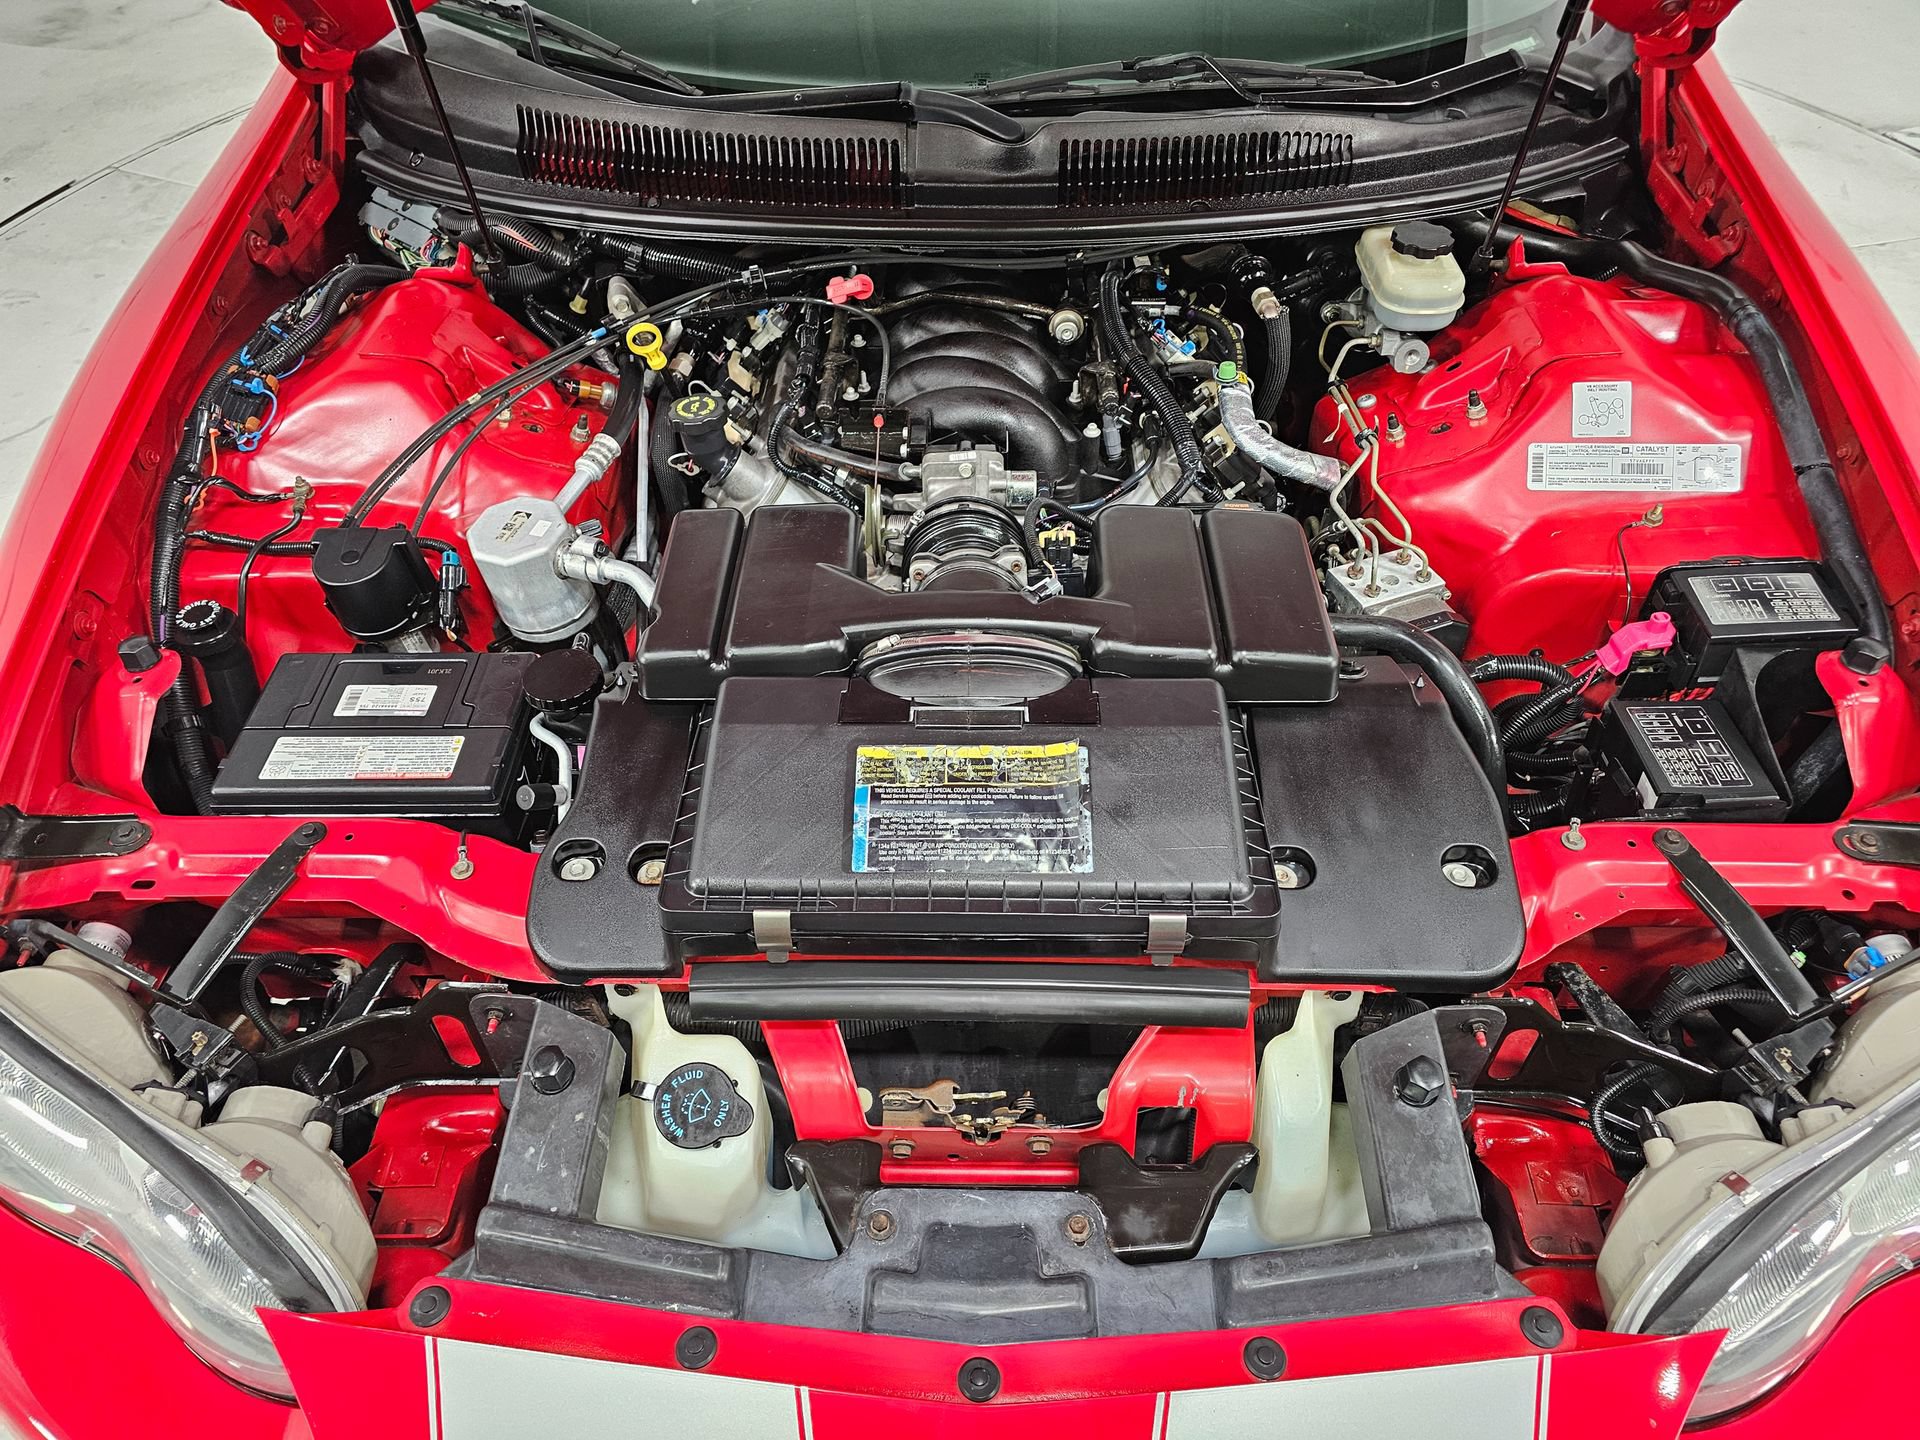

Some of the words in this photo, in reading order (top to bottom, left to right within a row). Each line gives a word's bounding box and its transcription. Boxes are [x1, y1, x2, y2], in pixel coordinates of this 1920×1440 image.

[672, 1070, 704, 1088] FLUID
[662, 1093, 684, 1138] WASHER
[714, 1100, 729, 1127] ONLY
